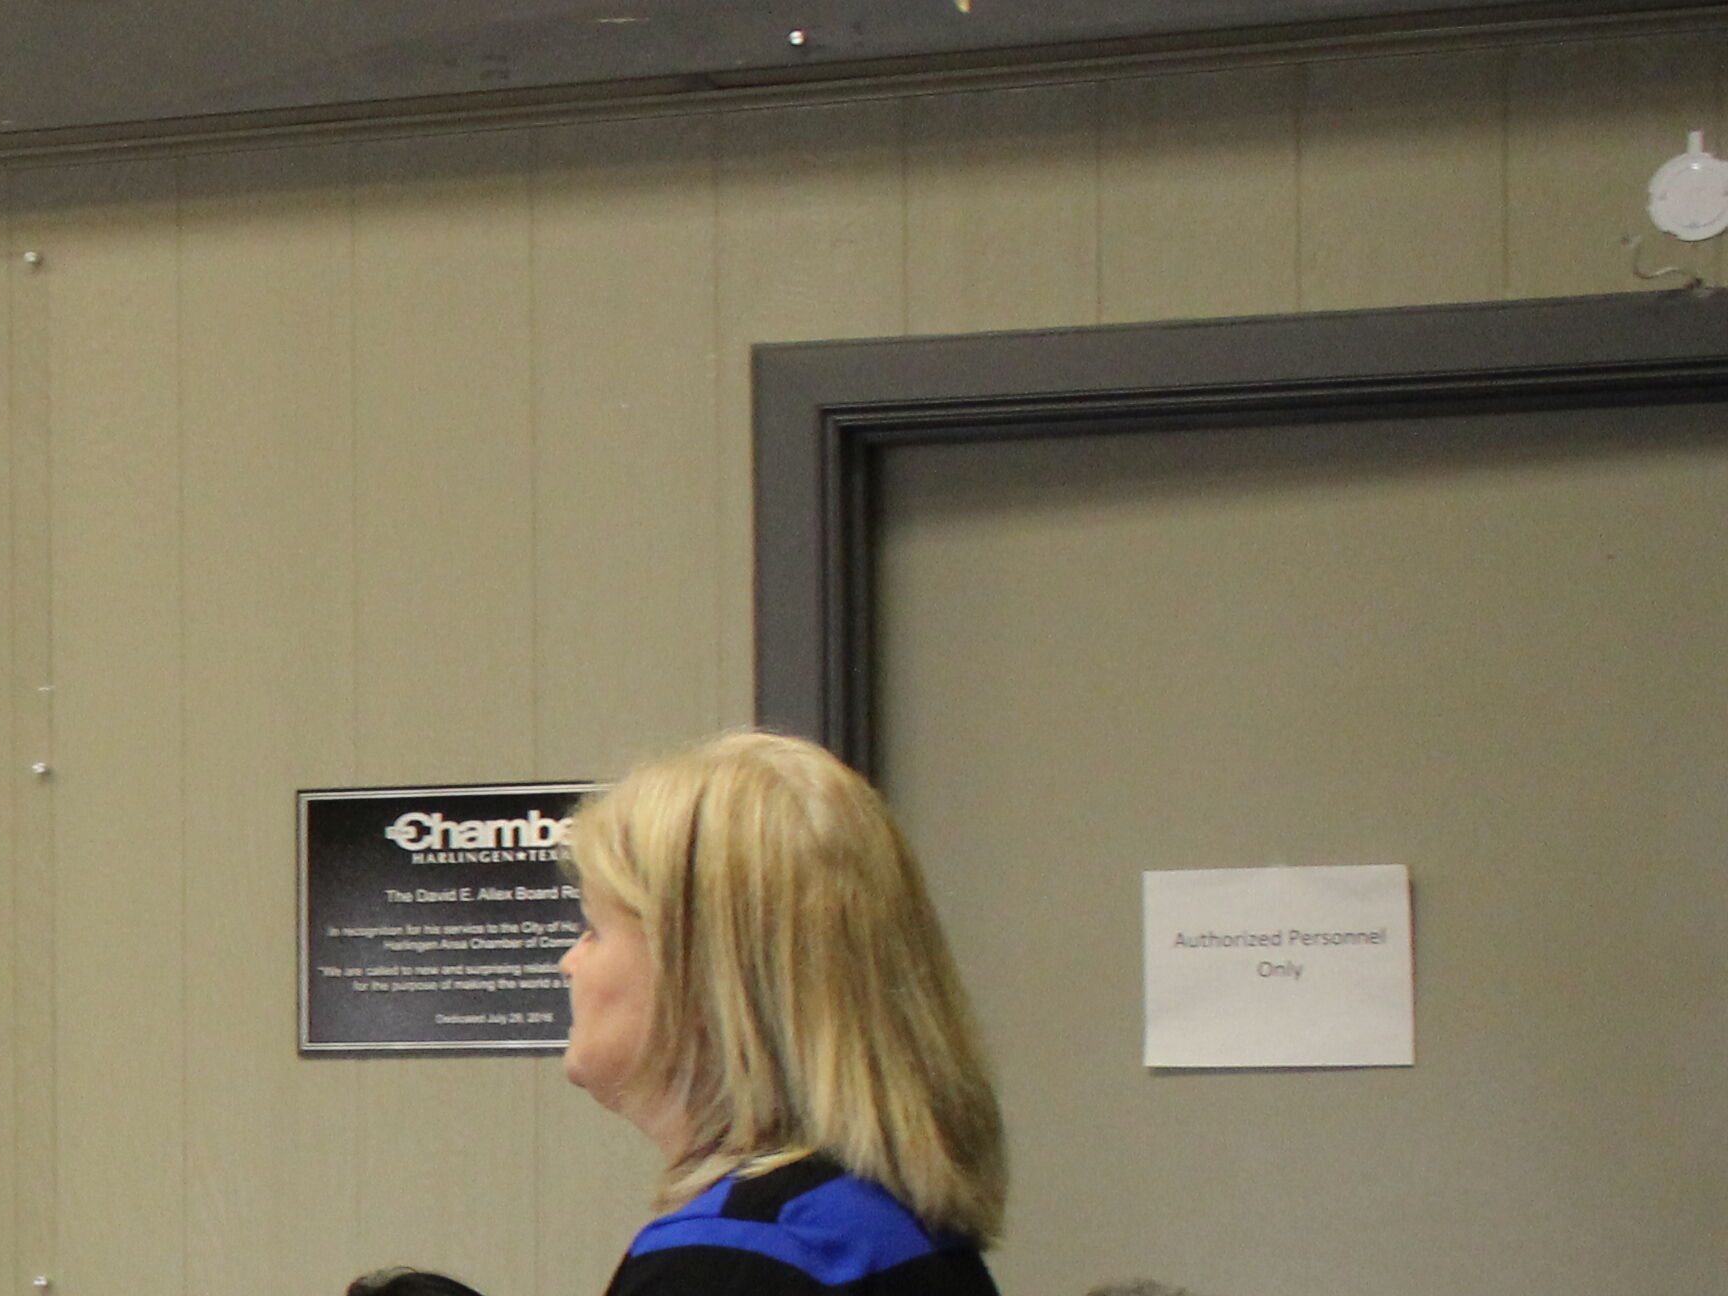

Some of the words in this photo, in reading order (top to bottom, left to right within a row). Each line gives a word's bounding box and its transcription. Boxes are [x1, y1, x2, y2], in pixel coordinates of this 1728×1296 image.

[384, 810, 574, 850] Chambe
[412, 851, 514, 864] HARLINGEN
[384, 889, 413, 902] The
[1173, 930, 1282, 949] Authorized
[1288, 928, 1387, 947] Personnel
[1257, 961, 1304, 980] Only
